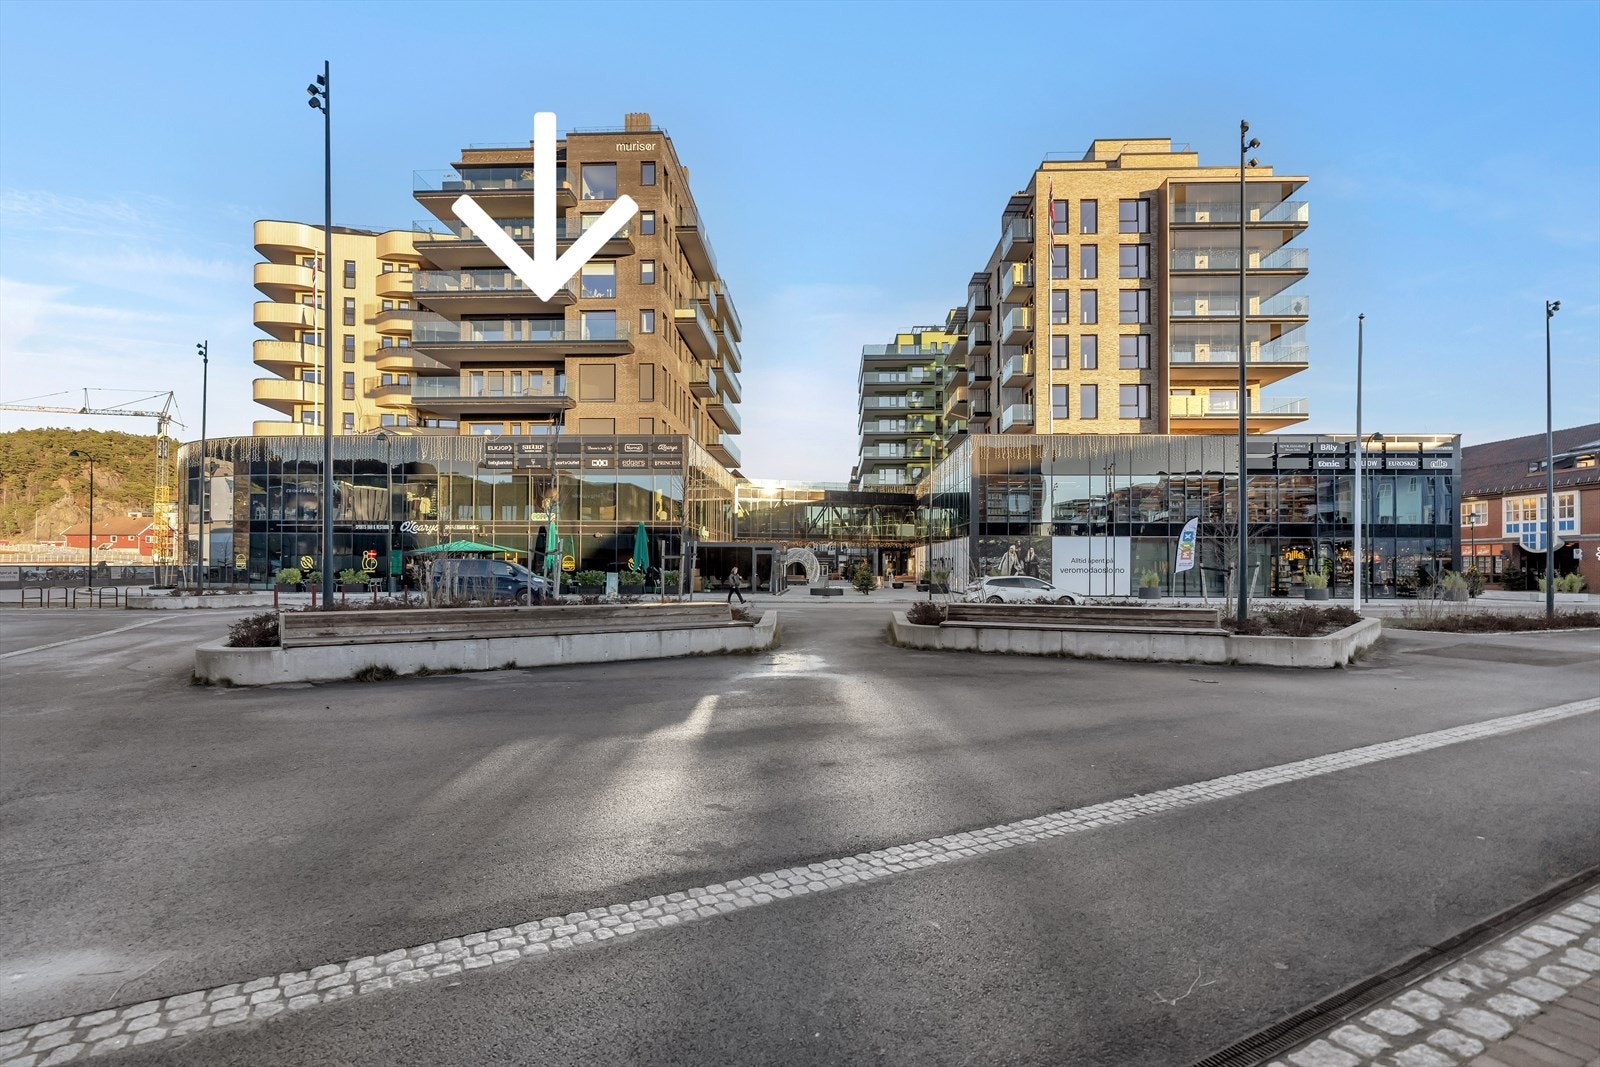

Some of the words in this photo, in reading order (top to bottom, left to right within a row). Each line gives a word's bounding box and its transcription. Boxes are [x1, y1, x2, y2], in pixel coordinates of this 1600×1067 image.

[616, 141, 656, 151] murisør
[1320, 444, 1338, 452] Billy
[1318, 459, 1340, 468] tonic
[1430, 459, 1448, 468] nille
[400, 520, 439, 535] O'Learys
[1285, 549, 1305, 561] nille
[1060, 566, 1125, 574] veromodaoslono
